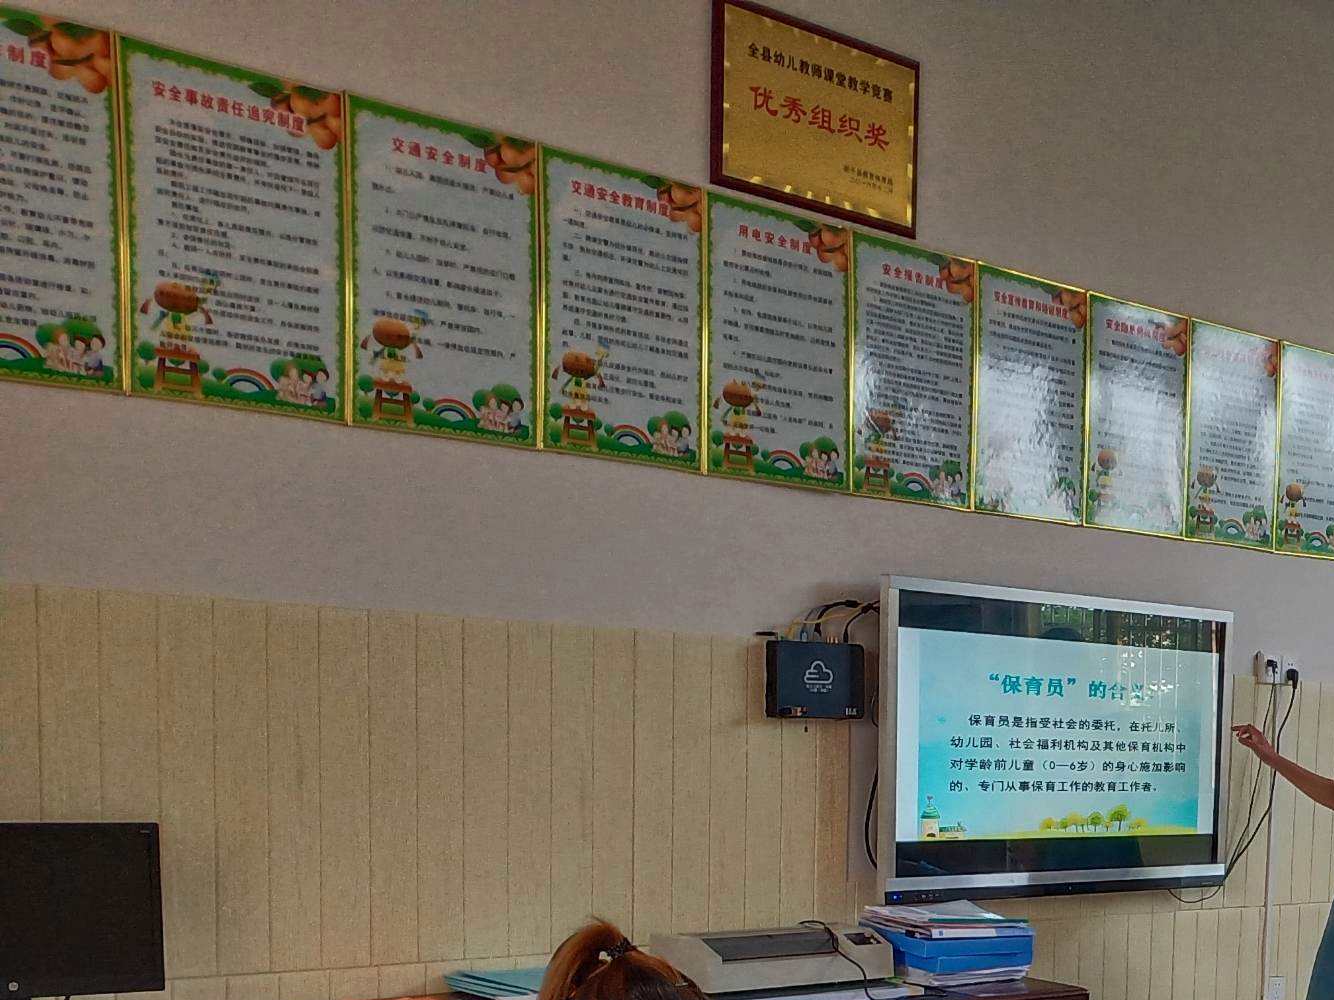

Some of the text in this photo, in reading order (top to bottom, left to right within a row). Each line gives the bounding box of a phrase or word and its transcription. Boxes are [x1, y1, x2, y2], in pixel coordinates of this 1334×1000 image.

[0, 42, 50, 69] 制度
[746, 42, 894, 104] 全县幼儿教师课堂教学竞赛
[152, 80, 306, 133] 安全事故责任追究制度
[749, 85, 891, 152] 优秀组织奖
[391, 136, 490, 174] 交通安全制度
[570, 179, 670, 218] 交通安全教育制度
[737, 223, 812, 256] 用电安全制度
[949, 735, 1188, 754] 幼儿园、社会福利机构及其他保育机构中
